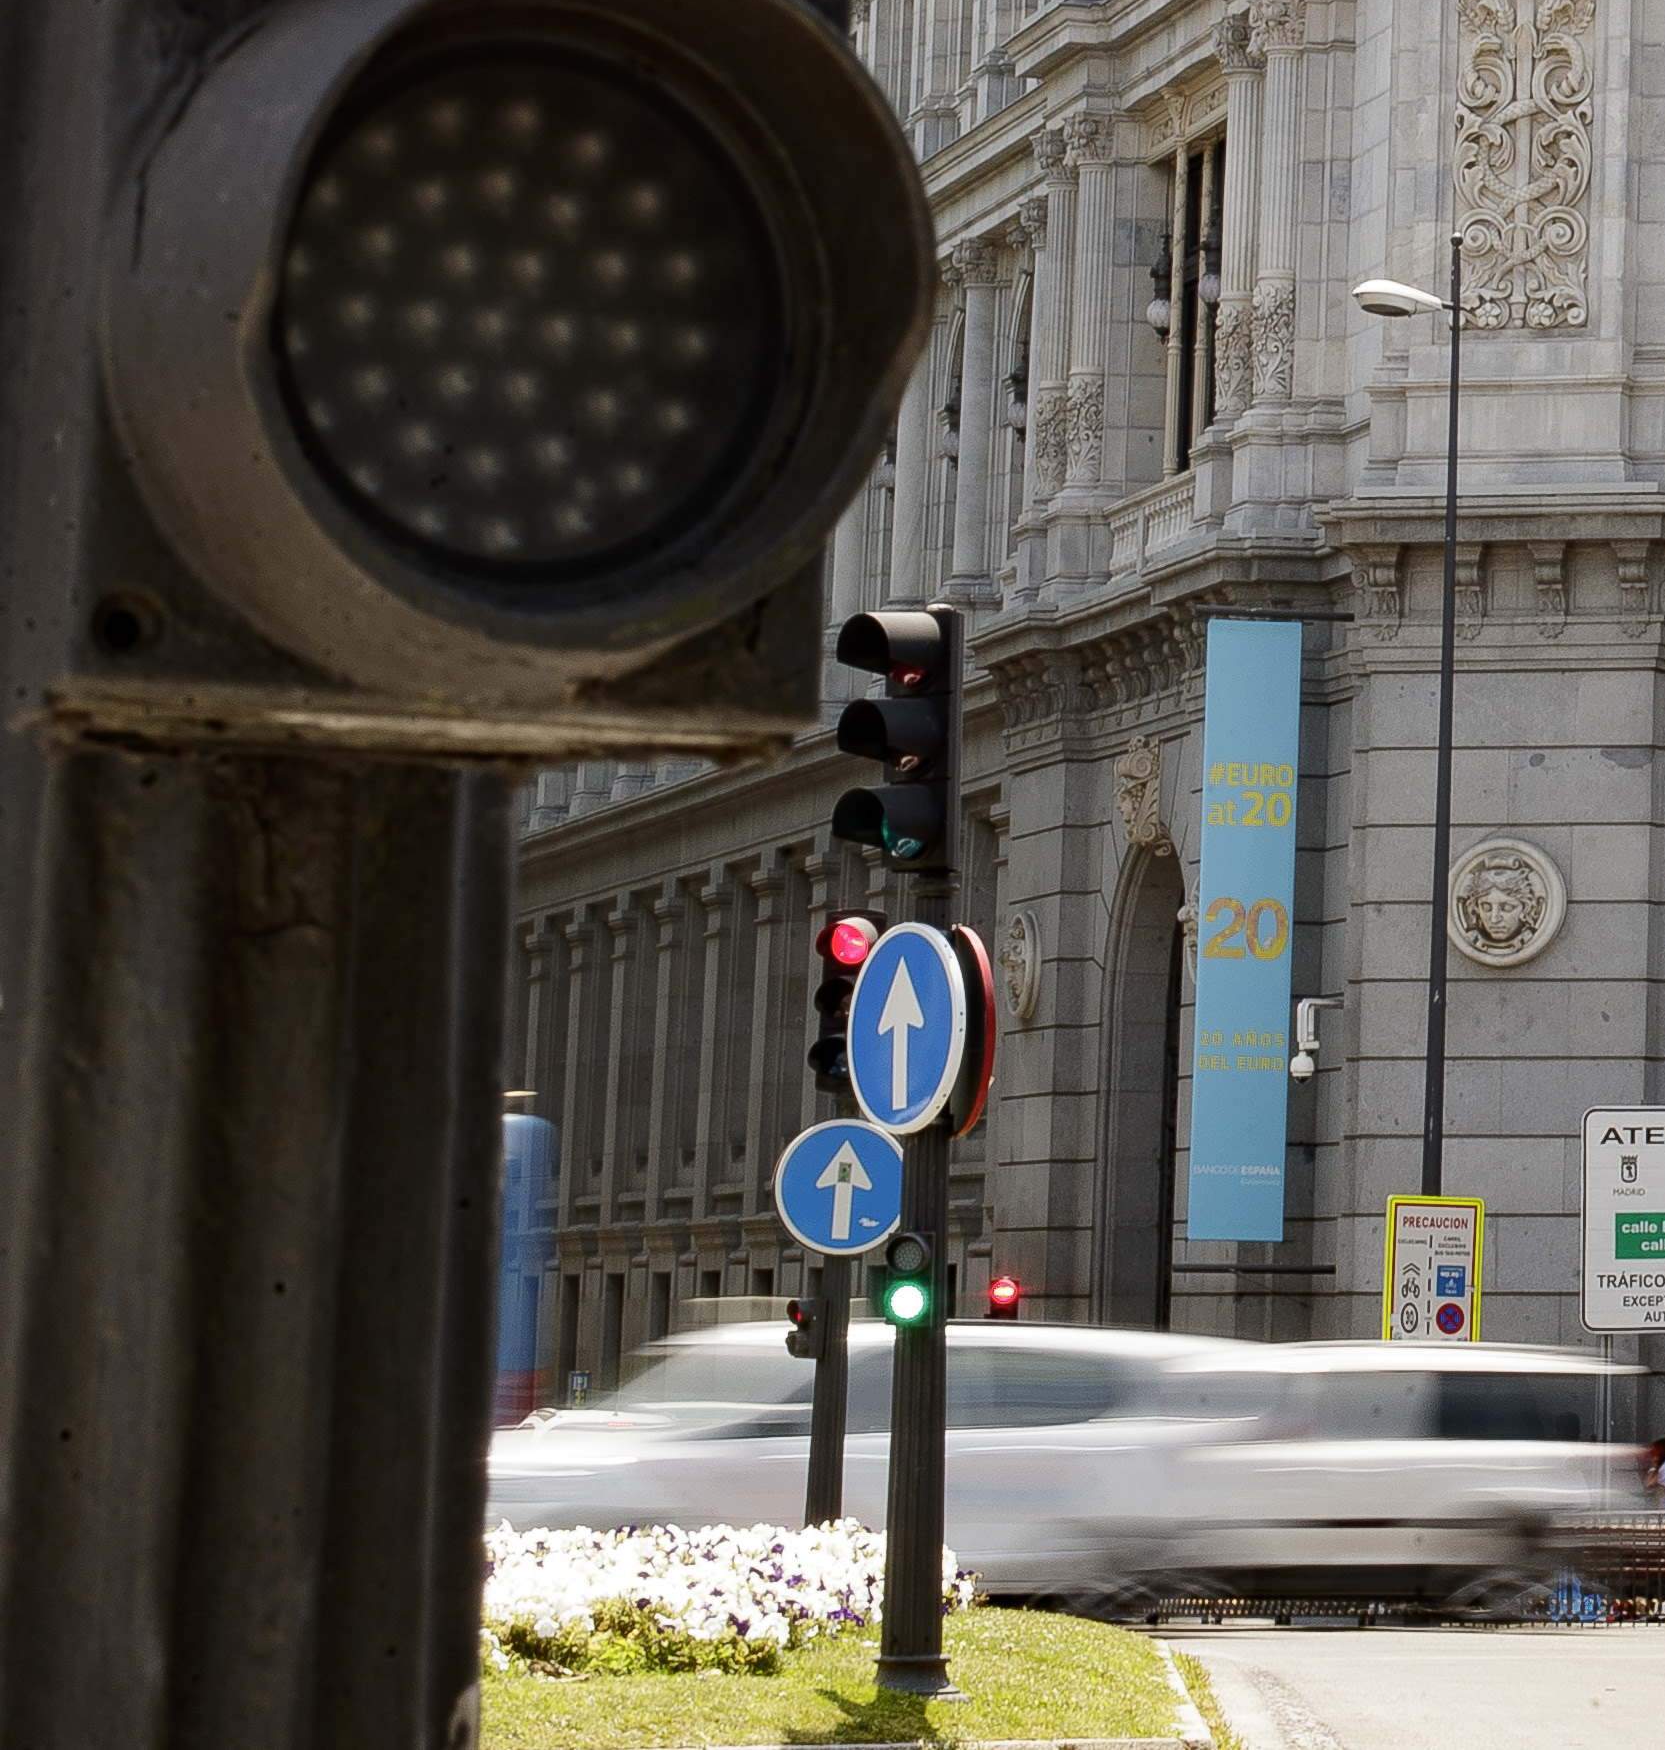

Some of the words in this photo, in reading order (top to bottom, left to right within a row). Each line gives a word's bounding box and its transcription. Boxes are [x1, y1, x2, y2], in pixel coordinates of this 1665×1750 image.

[1207, 762, 1294, 787] #EURO
[1207, 800, 1237, 826] at
[1241, 791, 1292, 827] 20
[1203, 897, 1289, 960] 20
[1613, 1188, 1646, 1196] MADRID
[1402, 1216, 1469, 1229] PRECAUCION
[1621, 1221, 1657, 1234] calle
[1597, 1271, 1665, 1288] TRÁFICO
